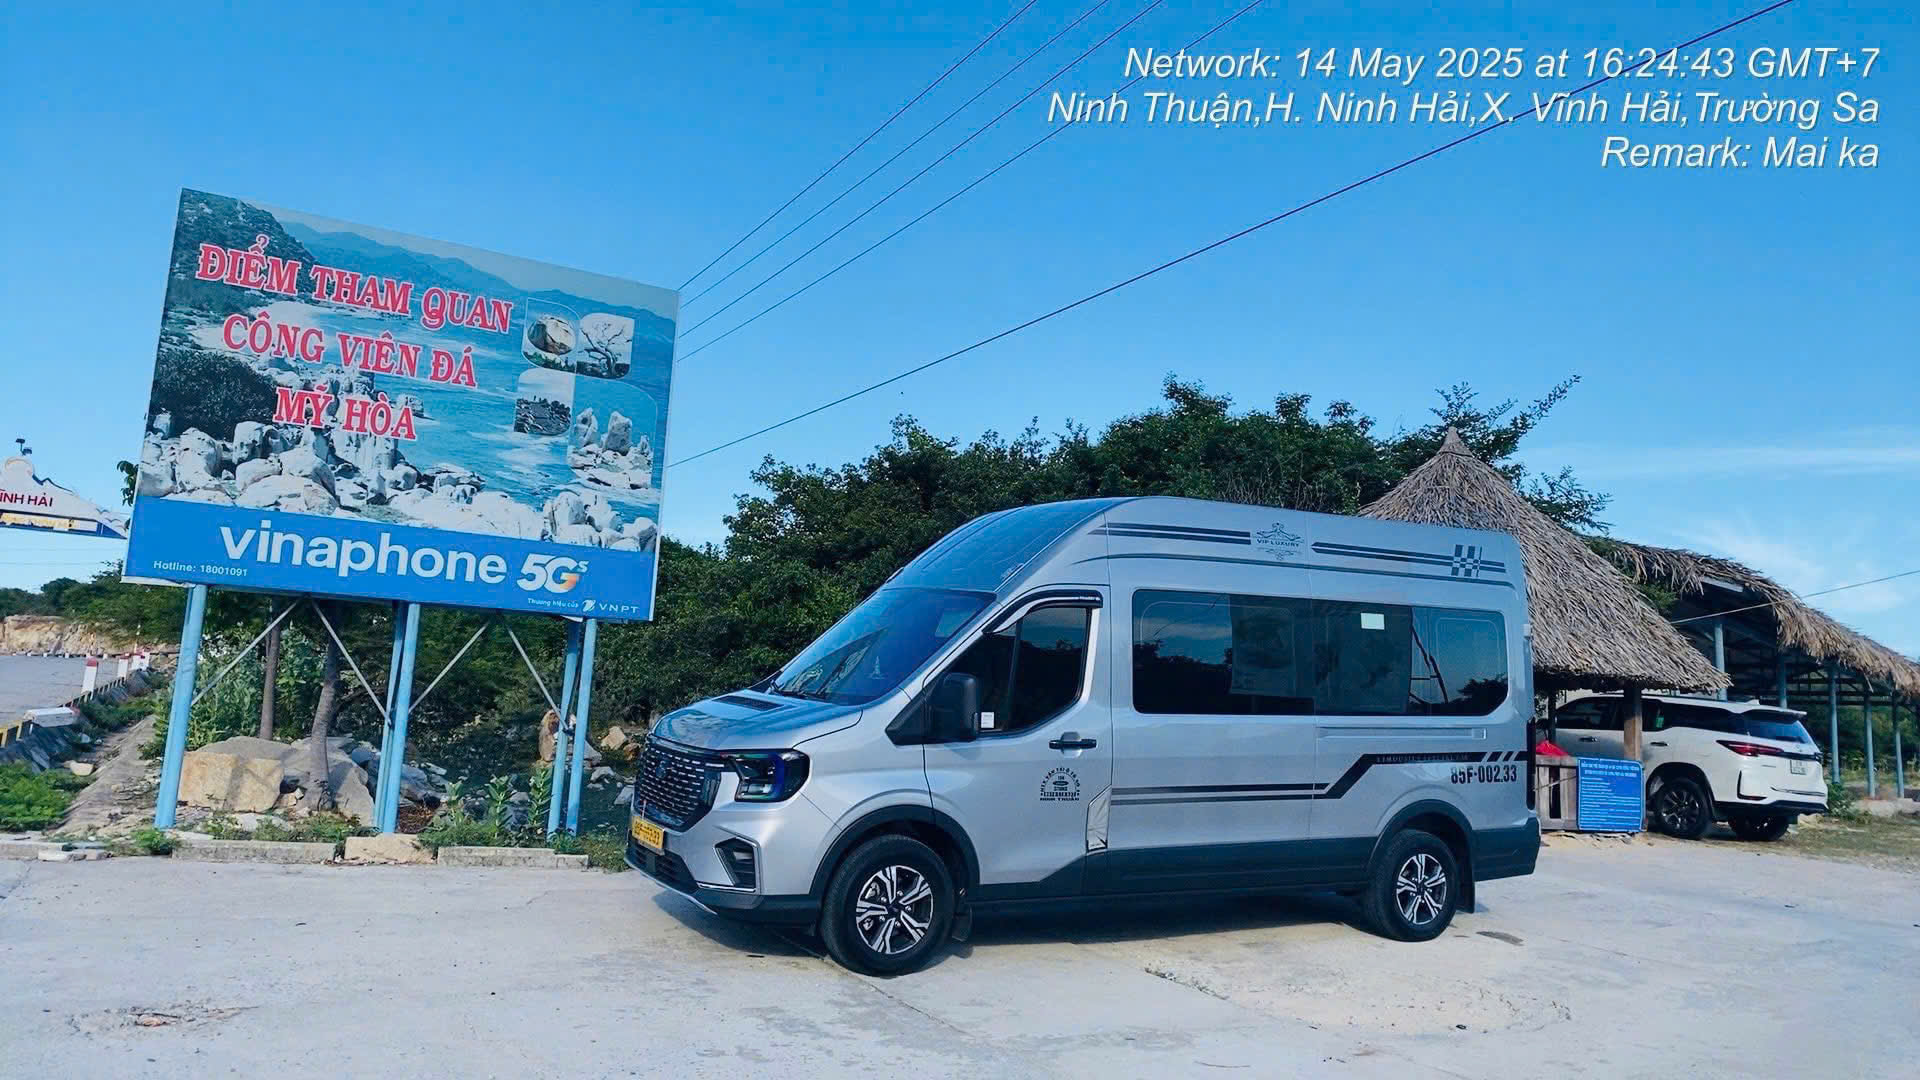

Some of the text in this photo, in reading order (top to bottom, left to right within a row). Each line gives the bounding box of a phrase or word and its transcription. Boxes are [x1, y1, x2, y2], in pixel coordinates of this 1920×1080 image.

[196, 234, 513, 334] ĐIỂM THAM QUAN
[223, 311, 477, 388] CÔNG VIÊN ĐÁ
[272, 384, 417, 441] MỸ HÒA
[27, 492, 53, 507] HẢI
[153, 560, 248, 577] Hotline: 18001091
[219, 519, 508, 584] vinaphone
[598, 602, 640, 614] VNPT
[1450, 764, 1518, 785] 85F-002.33
